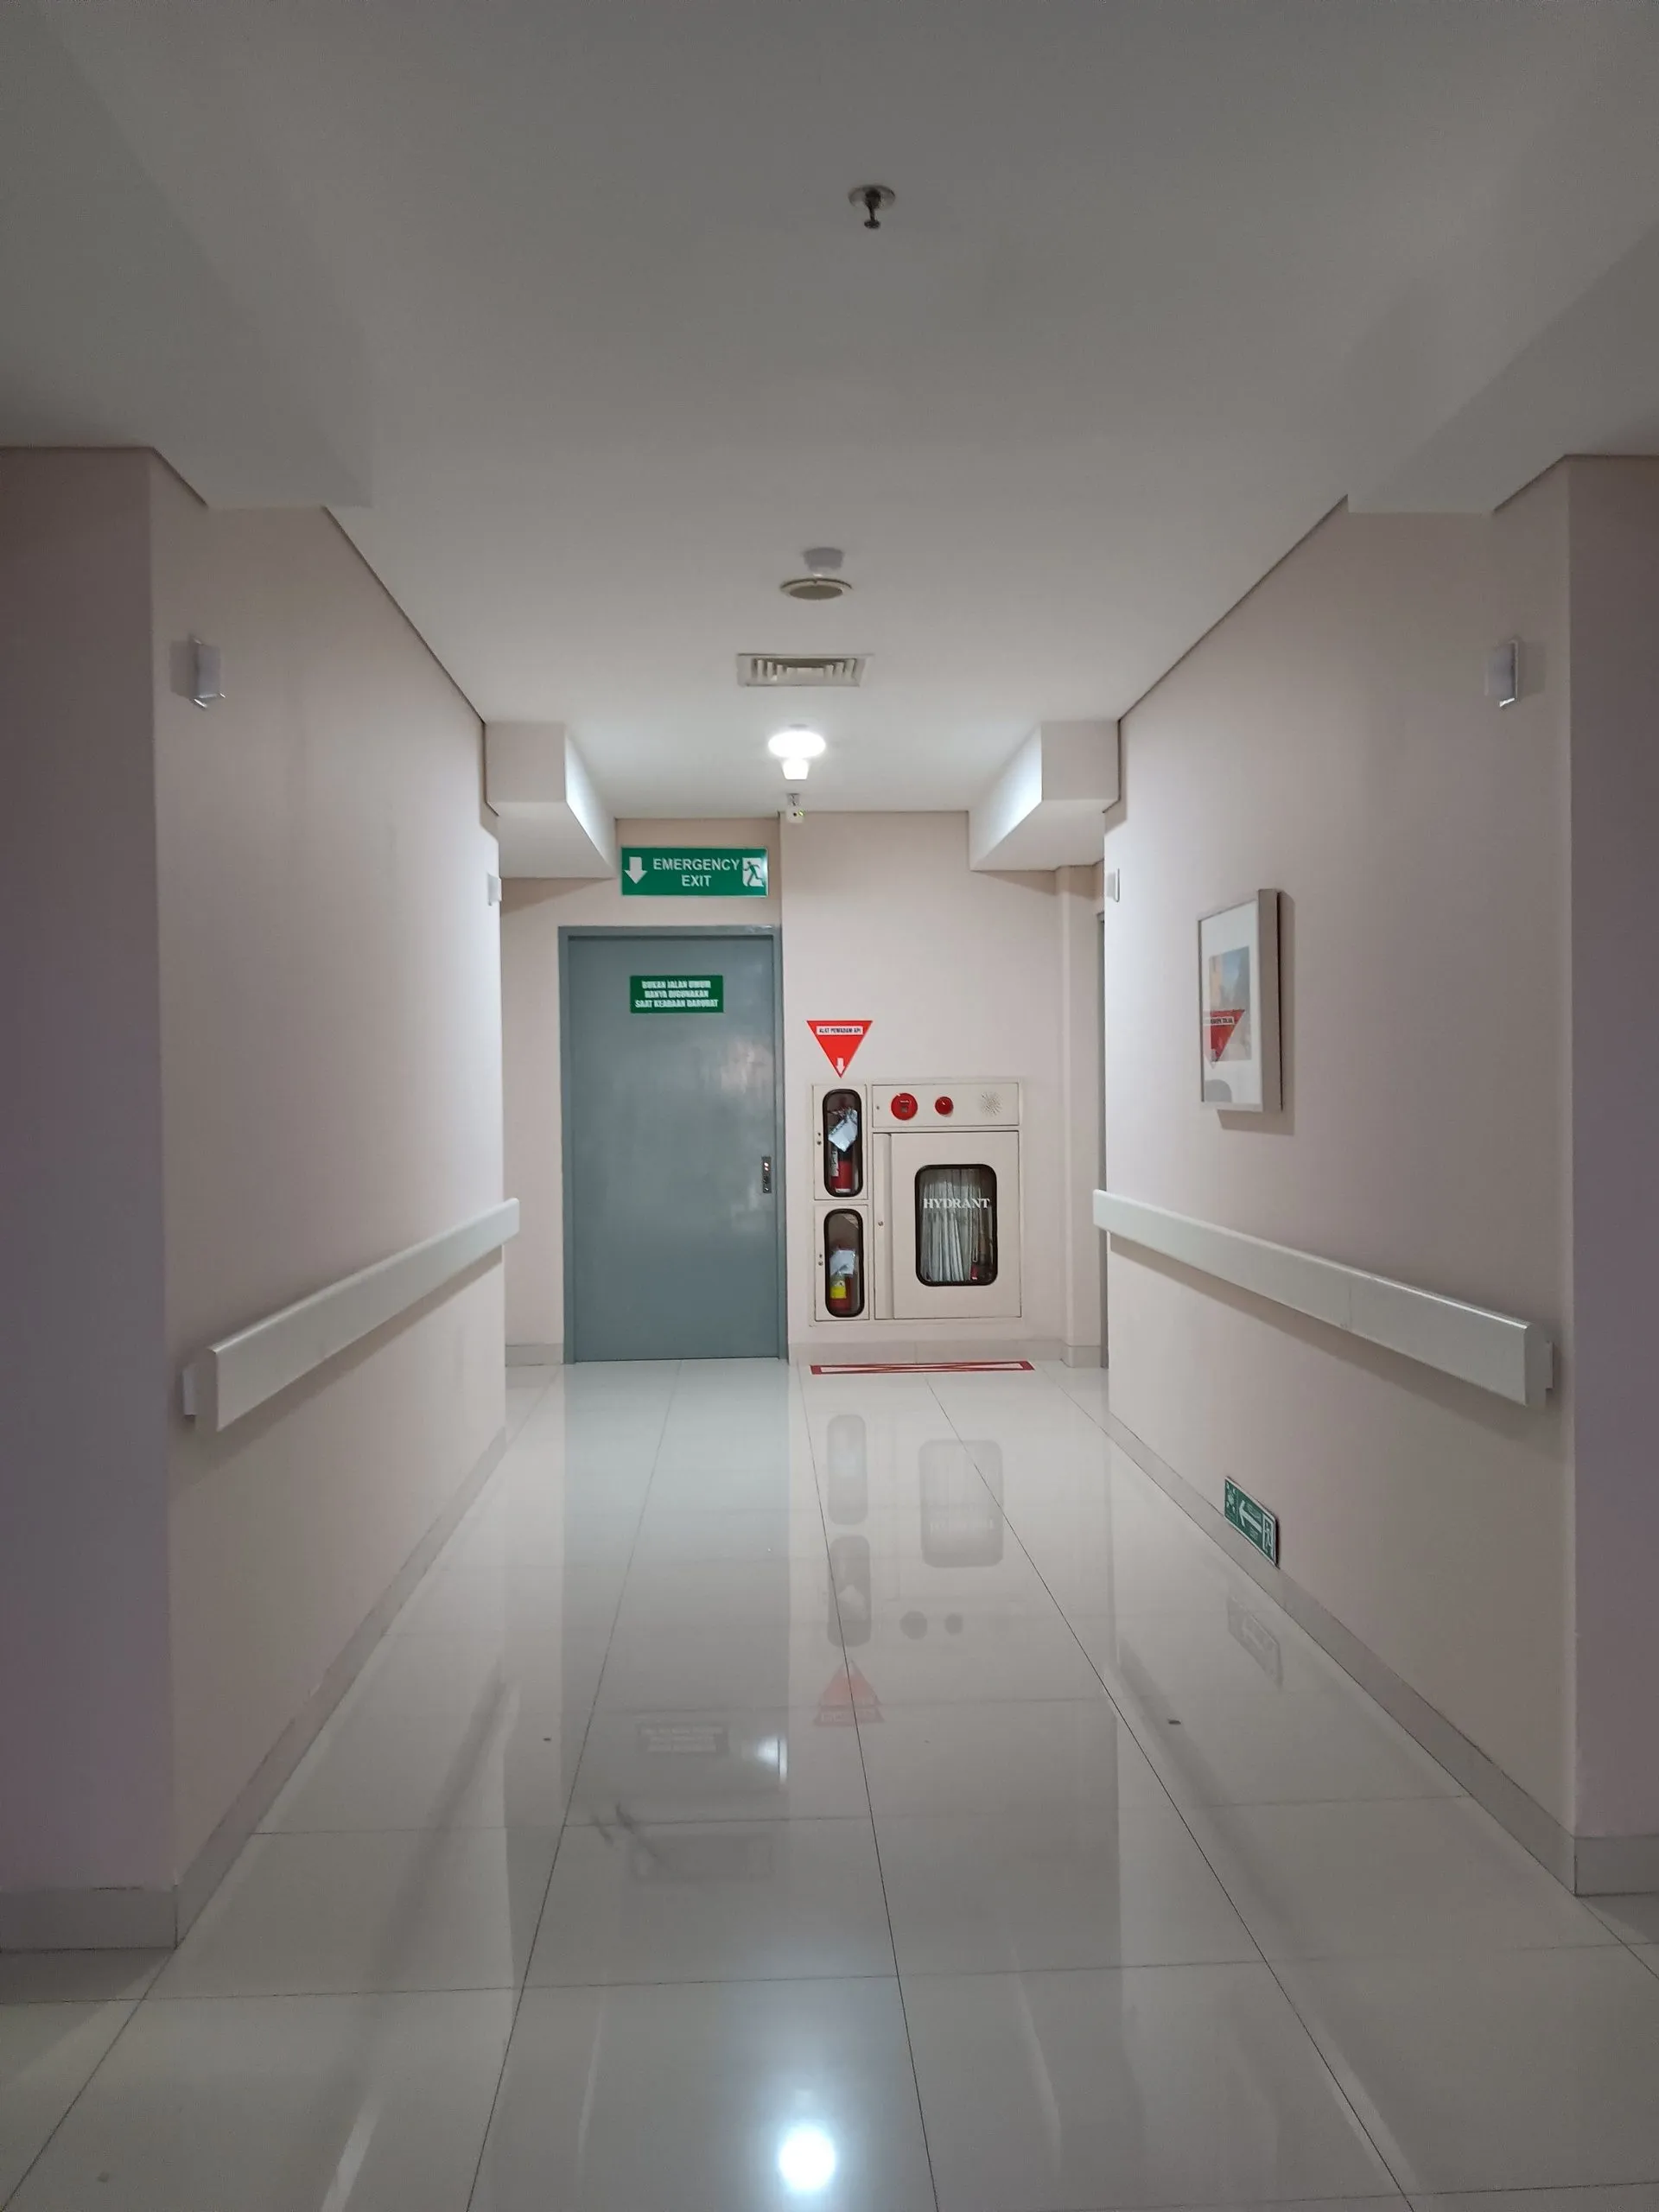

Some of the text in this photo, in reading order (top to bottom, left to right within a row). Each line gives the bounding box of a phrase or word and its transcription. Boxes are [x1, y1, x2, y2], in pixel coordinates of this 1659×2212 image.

[652, 857, 740, 870] EMERGENCY
[681, 874, 712, 887] EXIT
[641, 980, 666, 988] BUKAN
[667, 980, 688, 988] JALAN
[923, 1198, 990, 1209] HYDRANT
